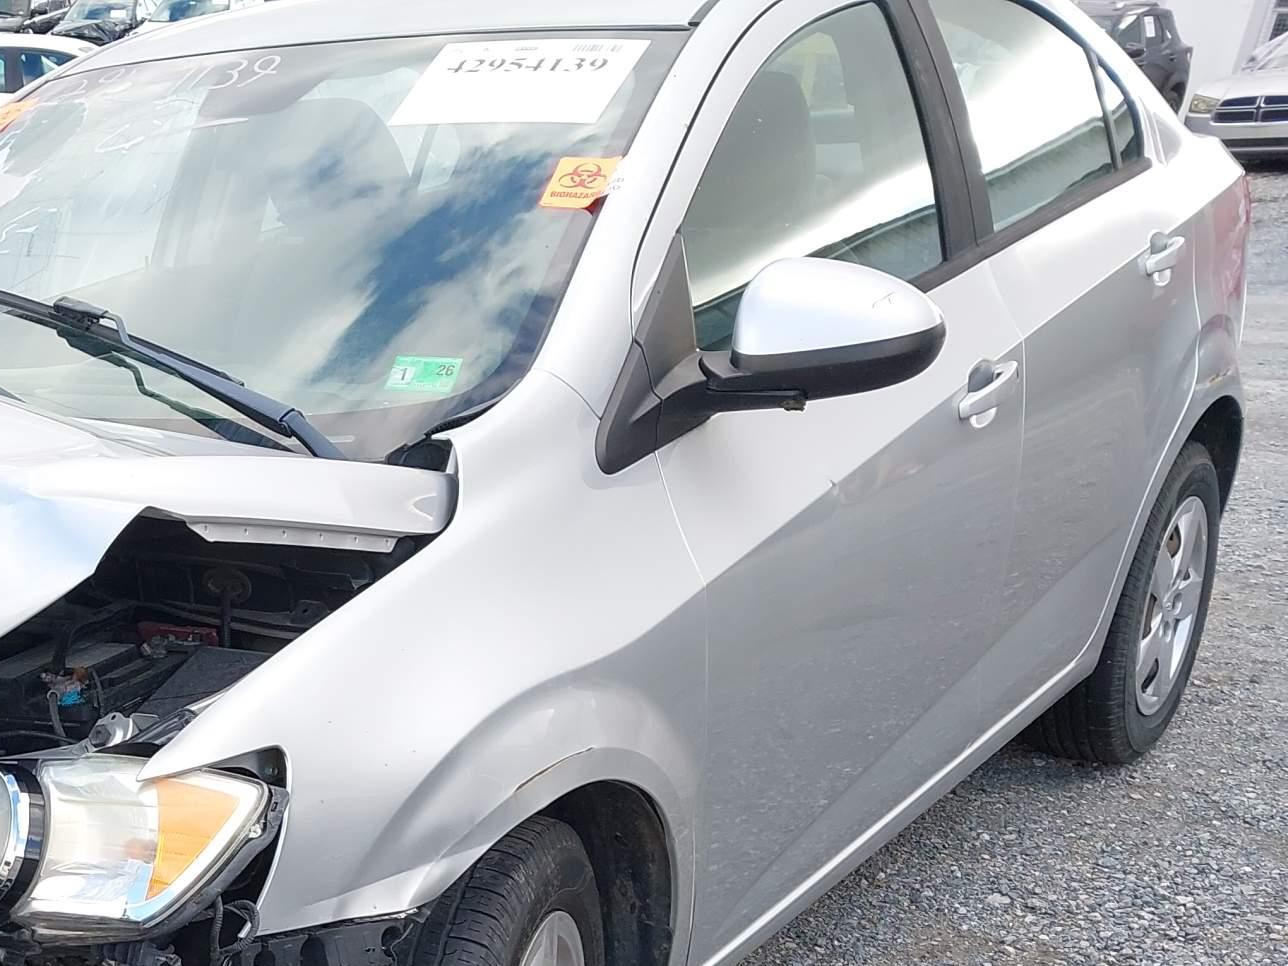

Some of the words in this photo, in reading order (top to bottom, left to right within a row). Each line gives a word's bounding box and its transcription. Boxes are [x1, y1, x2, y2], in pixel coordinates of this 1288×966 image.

[447, 57, 609, 73] 42954139
[400, 367, 409, 381] 1
[436, 364, 456, 377] 26
